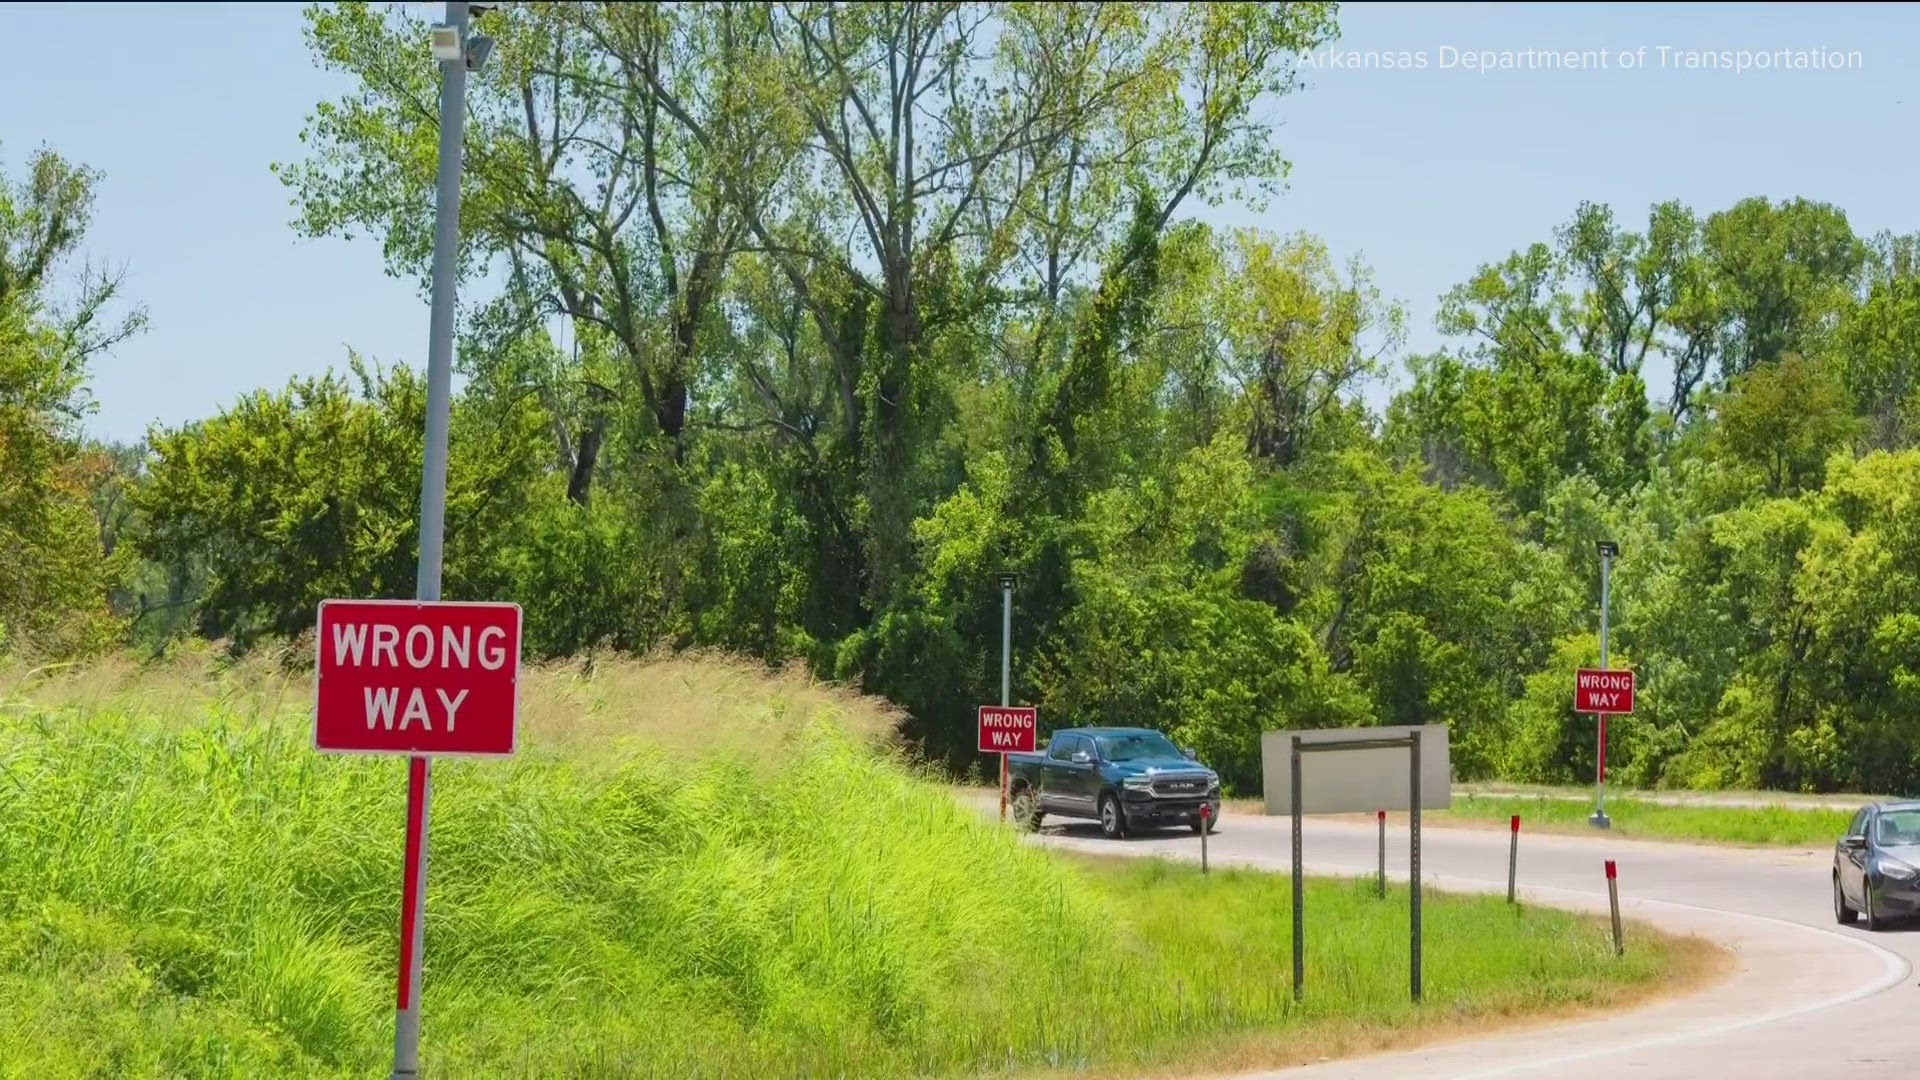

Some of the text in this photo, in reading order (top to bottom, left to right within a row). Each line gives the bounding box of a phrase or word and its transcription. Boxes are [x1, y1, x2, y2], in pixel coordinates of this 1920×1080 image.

[332, 623, 507, 671] WRONG
[1579, 675, 1631, 690] WRONG
[1588, 692, 1620, 707] WAY
[363, 686, 470, 732] WAY
[983, 712, 1033, 729] WRONG
[992, 731, 1023, 747] WAY
